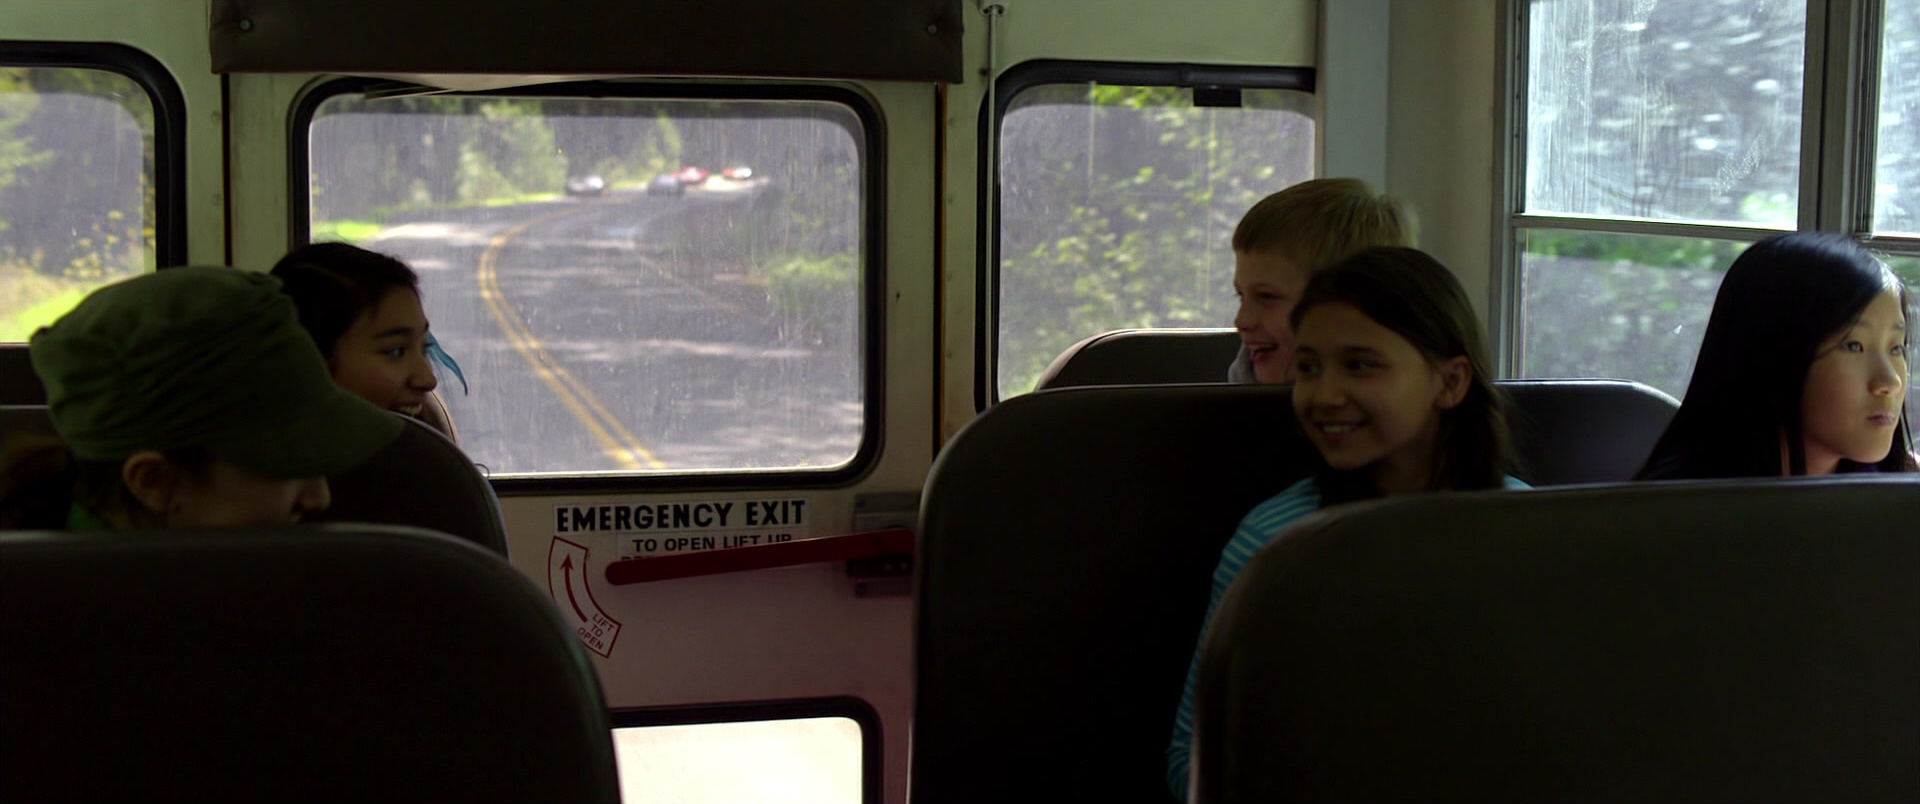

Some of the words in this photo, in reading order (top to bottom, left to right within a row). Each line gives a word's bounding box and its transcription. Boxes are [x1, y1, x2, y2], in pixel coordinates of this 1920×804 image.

[557, 502, 733, 532] EMERGENCY
[746, 500, 805, 526] EXIT
[632, 539, 657, 552] TO
[664, 537, 715, 551] OPEN
[723, 534, 761, 548] LIFT
[591, 624, 604, 637] TO
[592, 613, 615, 632] LIFT
[577, 627, 604, 649] OPEN
